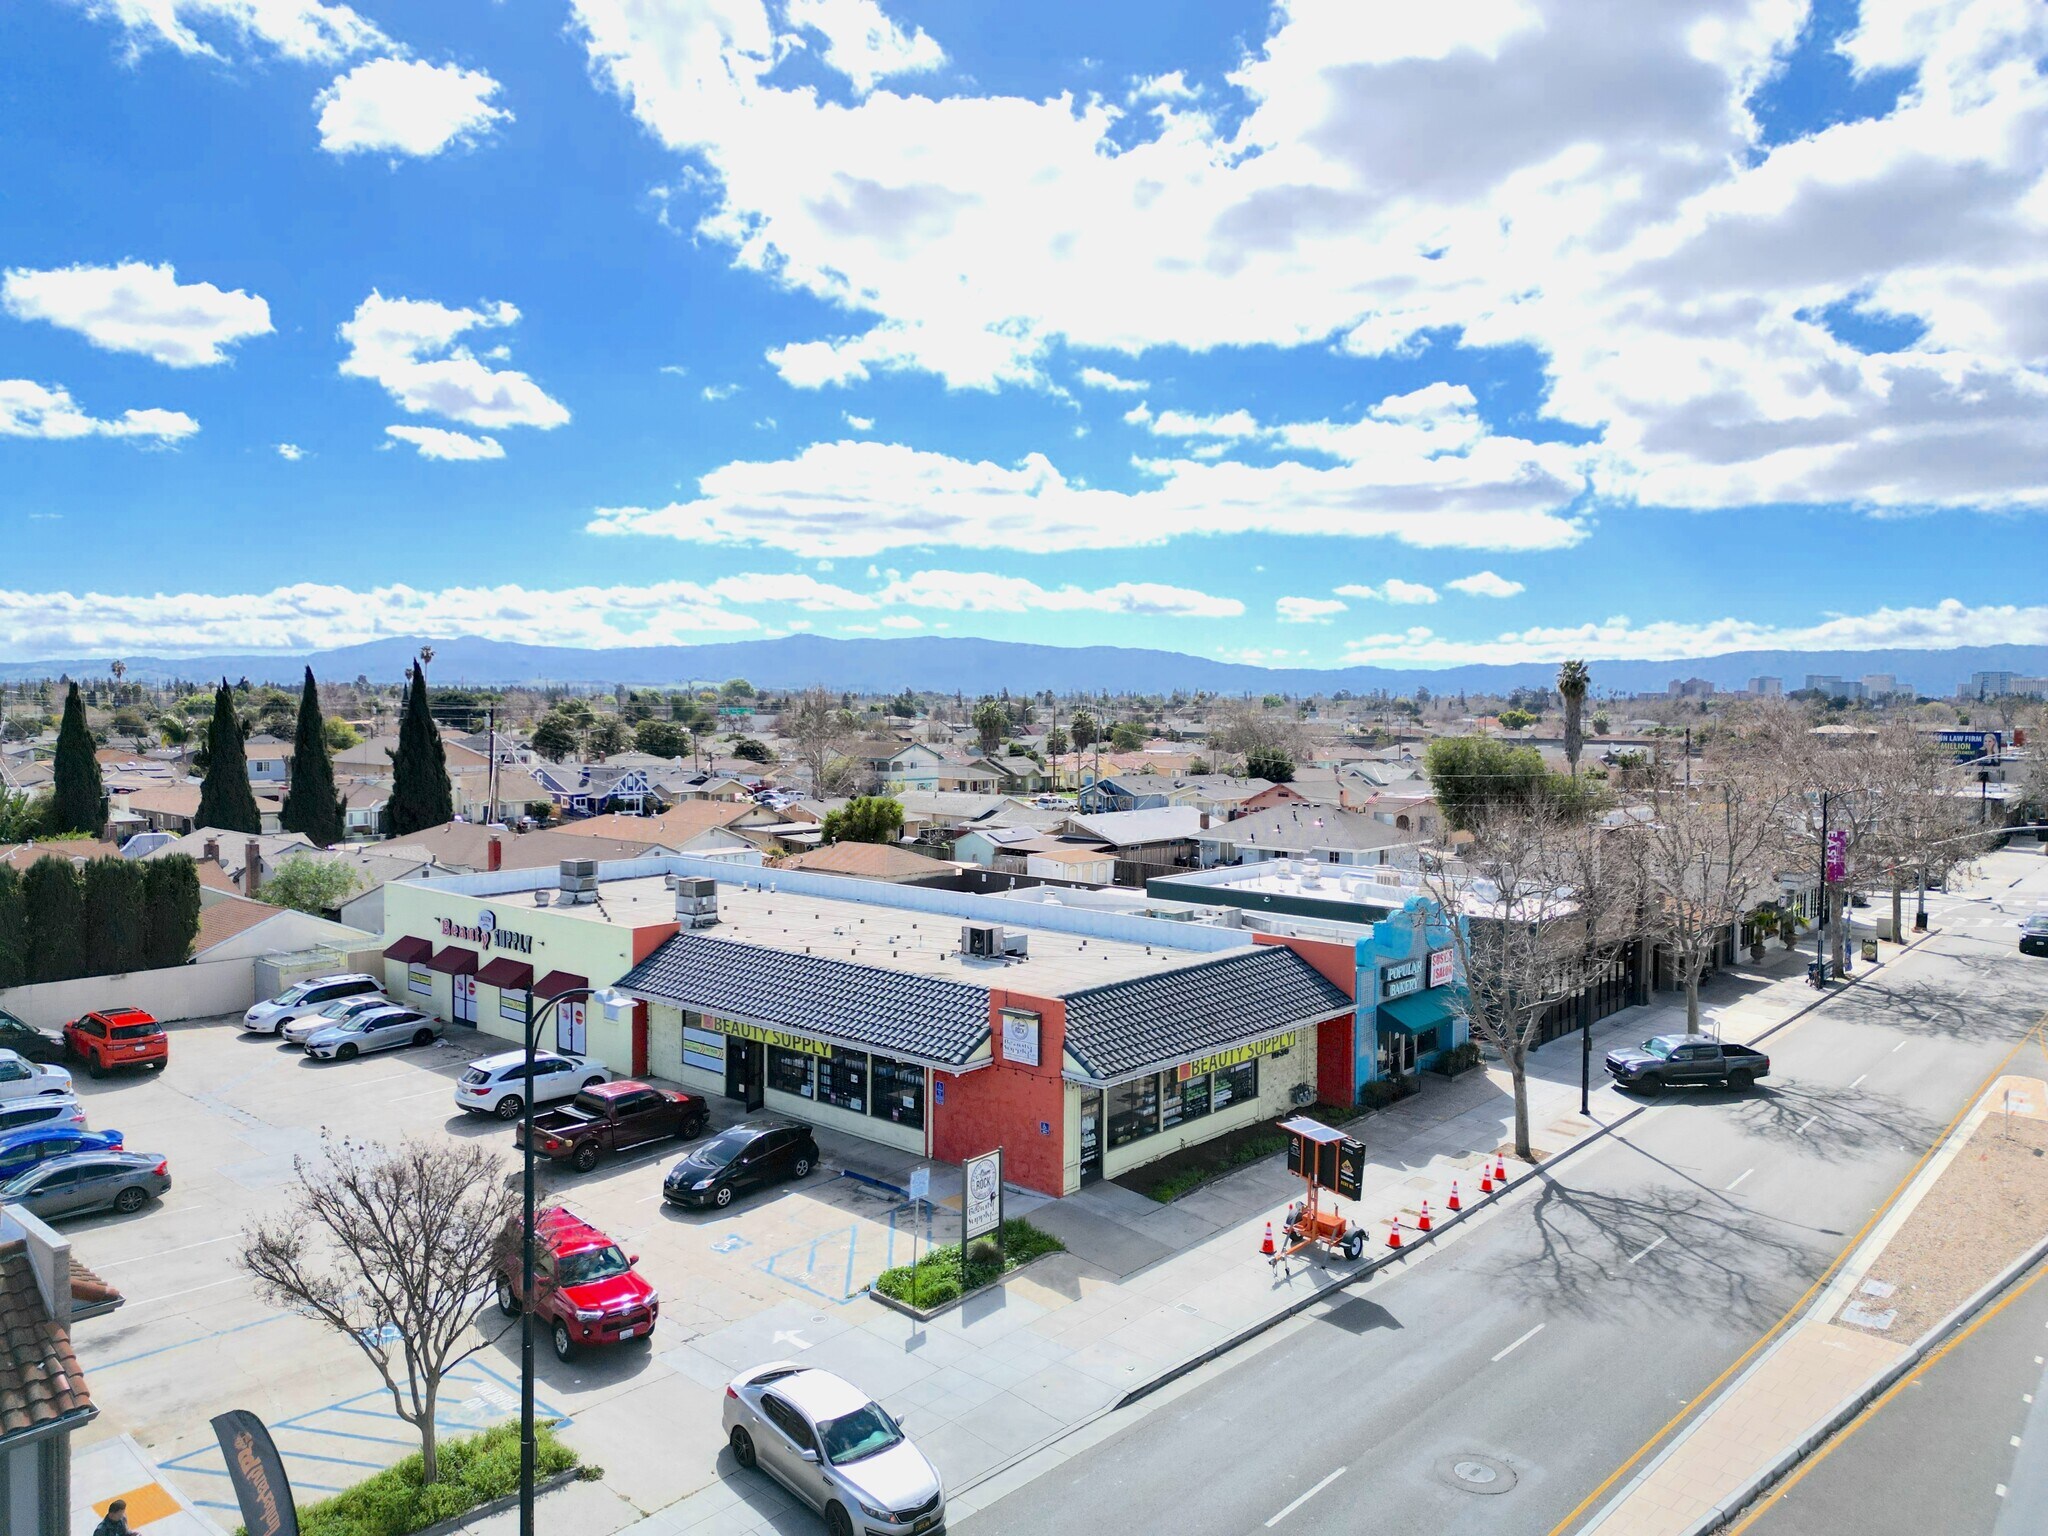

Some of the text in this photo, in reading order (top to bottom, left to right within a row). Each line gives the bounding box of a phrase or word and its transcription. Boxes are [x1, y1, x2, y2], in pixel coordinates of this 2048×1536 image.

[1827, 831, 1838, 865] EAST
[442, 918, 491, 950] Beauty
[494, 929, 532, 954] SUPPLY
[1387, 961, 1422, 981] POPULAR
[1389, 978, 1418, 997] BAKERY
[714, 1018, 831, 1056] BEAUTY SUPPLY
[1192, 1031, 1294, 1077] BEAUTY SUPPLY
[976, 1176, 991, 1191] ROCK
